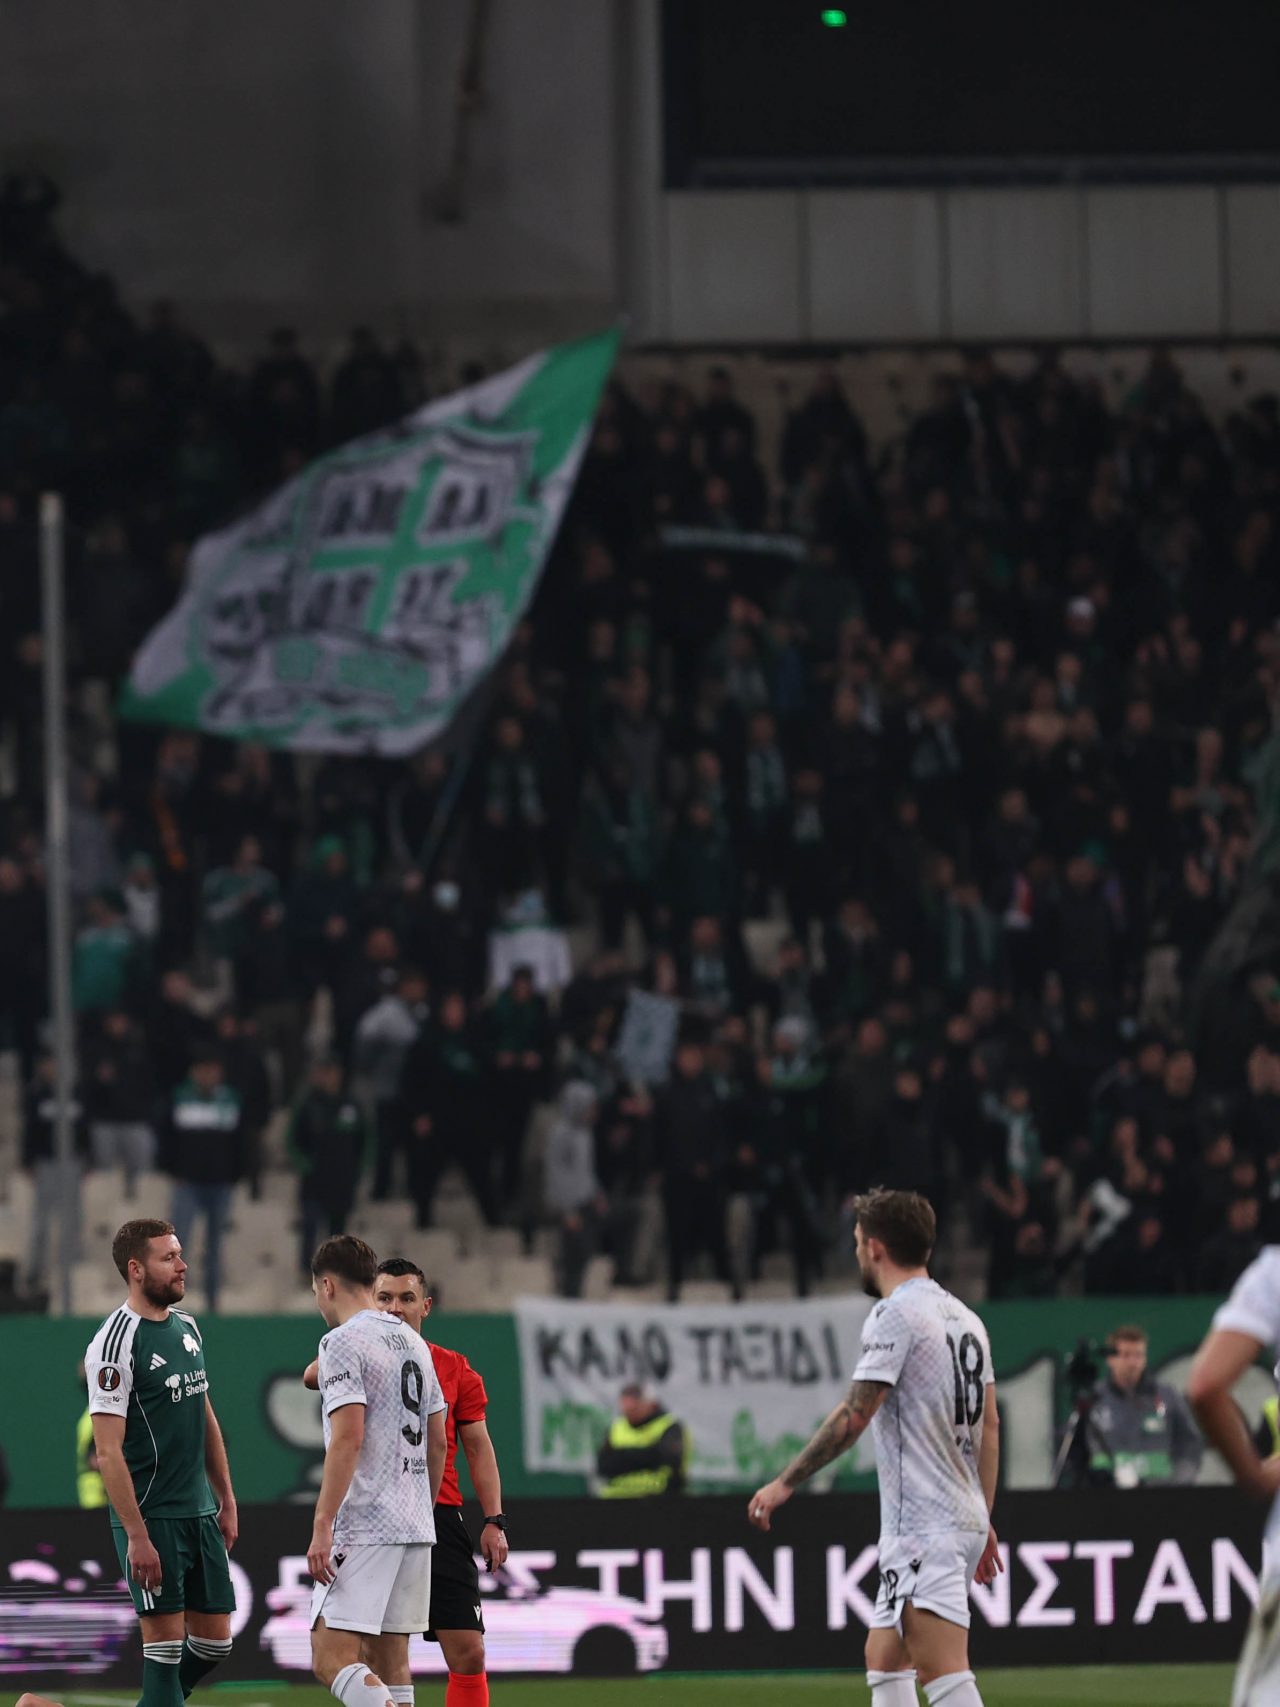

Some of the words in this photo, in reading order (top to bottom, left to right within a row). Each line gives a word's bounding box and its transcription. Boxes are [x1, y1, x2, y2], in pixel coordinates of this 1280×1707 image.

[184, 1374, 192, 1385] A
[535, 1322, 671, 1381] ΚΑΛΟ
[686, 1322, 842, 1384] ΤΑΞΙΔΙ
[946, 1332, 984, 1427] 18
[401, 1359, 424, 1447] 9
